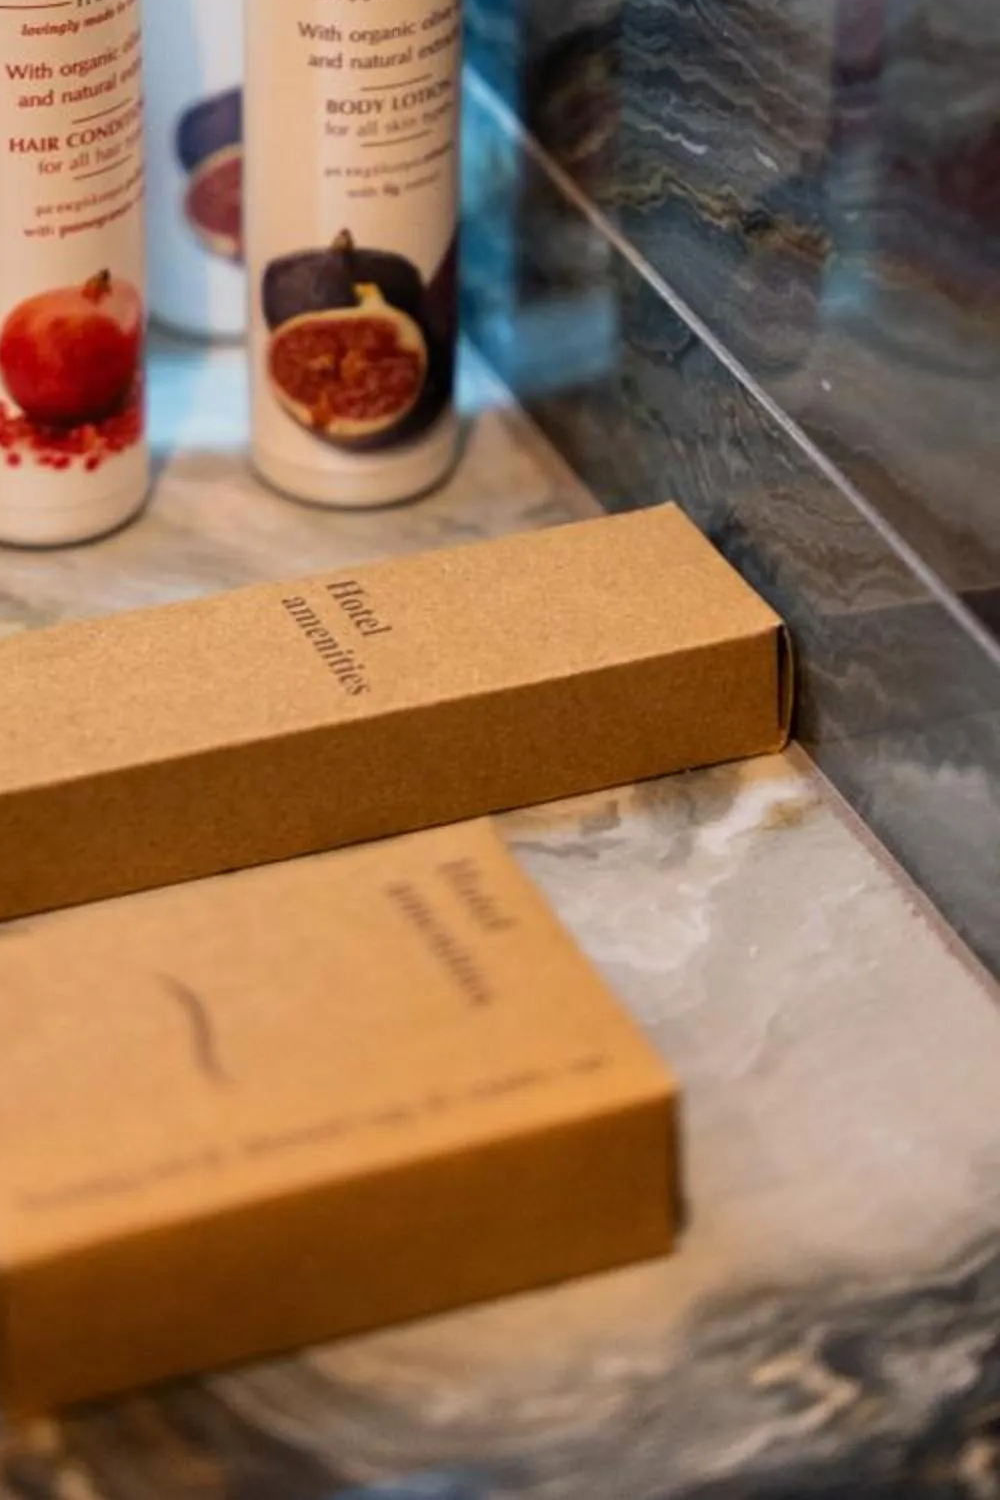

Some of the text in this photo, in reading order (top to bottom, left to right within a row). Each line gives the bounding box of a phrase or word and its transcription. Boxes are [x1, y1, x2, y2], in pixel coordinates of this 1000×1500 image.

[298, 21, 341, 42] With
[308, 53, 342, 68] and
[6, 63, 53, 80] With
[18, 89, 54, 108] and
[9, 138, 60, 153] HAIR
[326, 580, 392, 637] Hotel
[282, 596, 371, 695] amenities
